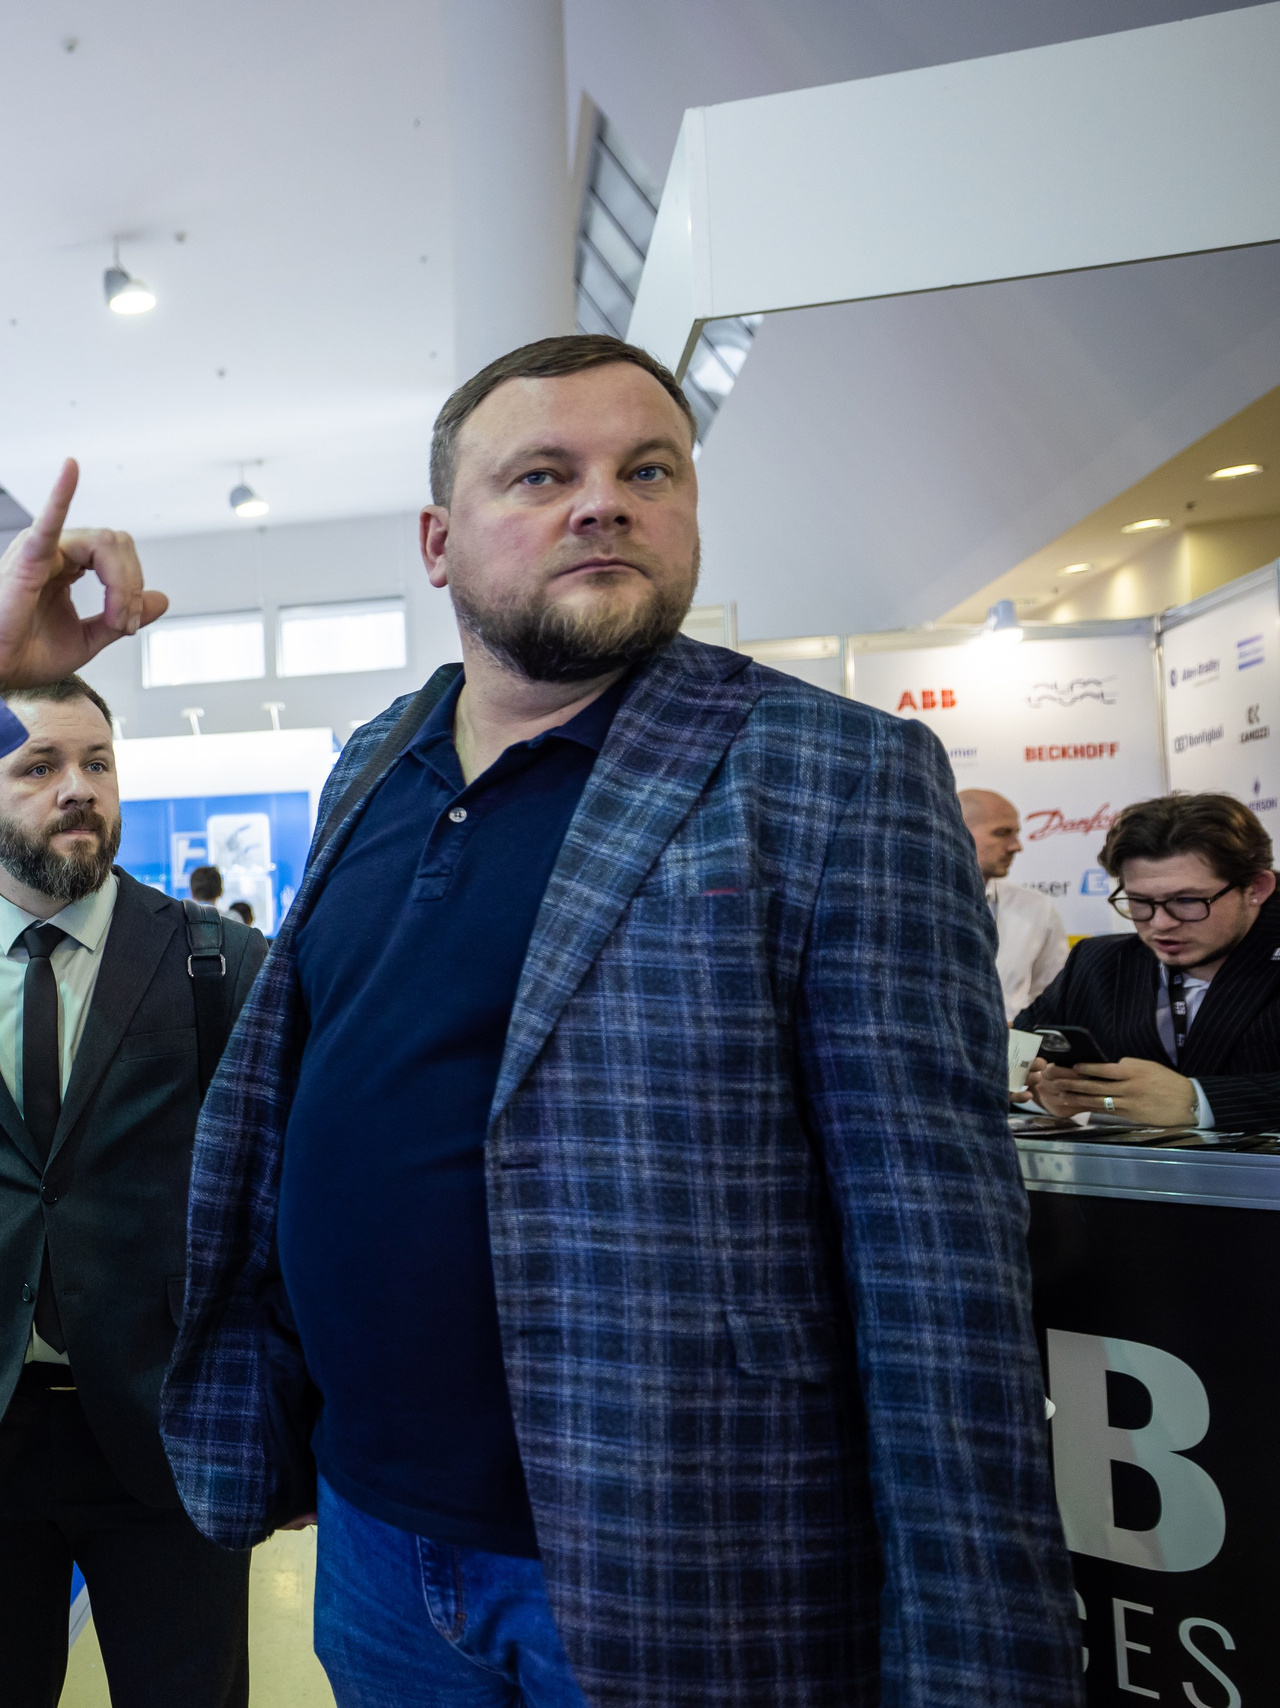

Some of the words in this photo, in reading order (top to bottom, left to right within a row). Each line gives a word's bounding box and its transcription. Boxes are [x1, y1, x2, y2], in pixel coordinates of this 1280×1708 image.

[897, 689, 957, 712] ABB
[1024, 742, 1118, 762] BECKHOFF
[1074, 1588, 1242, 1708] ES
